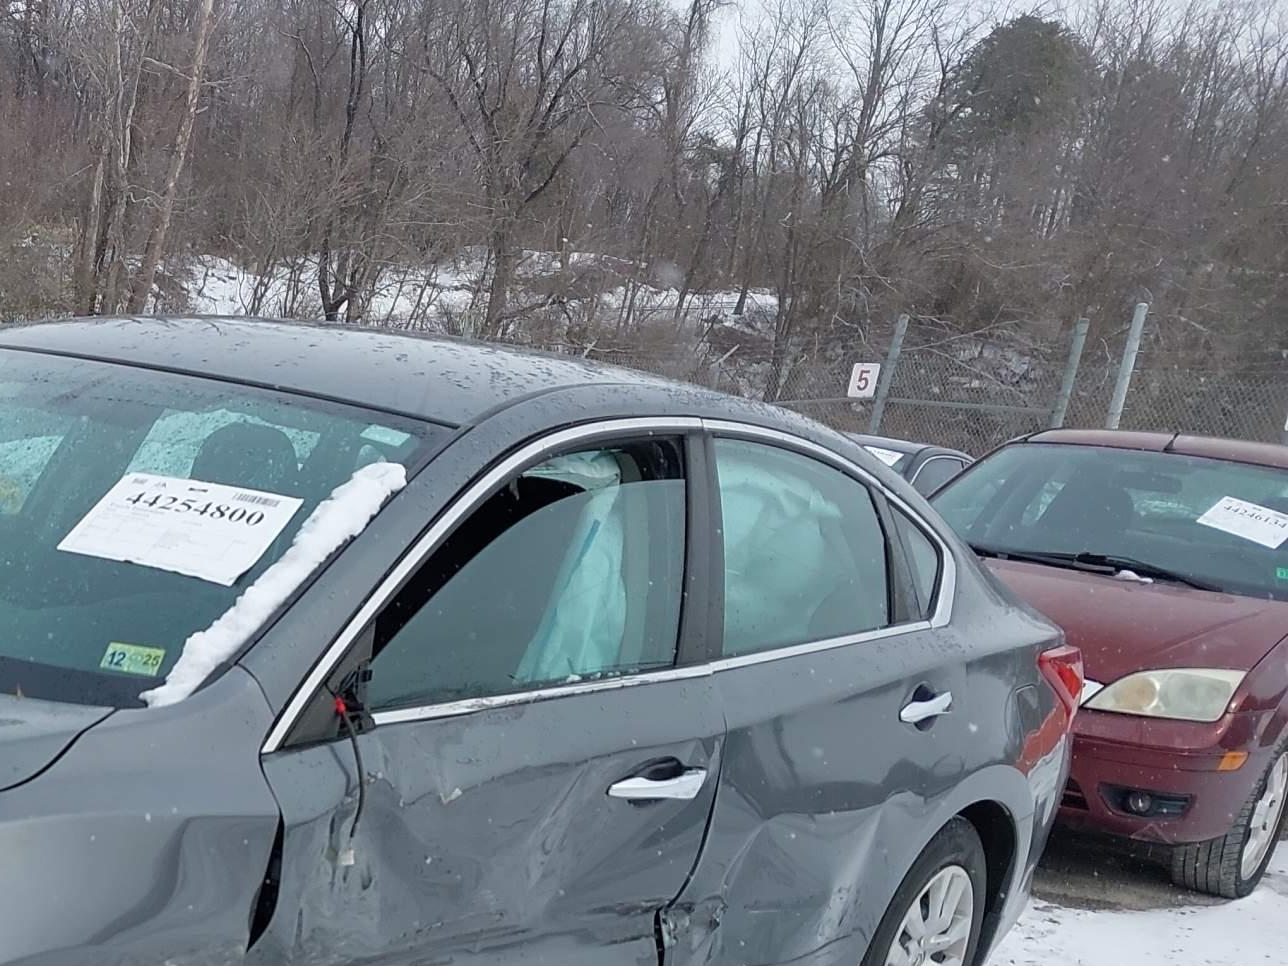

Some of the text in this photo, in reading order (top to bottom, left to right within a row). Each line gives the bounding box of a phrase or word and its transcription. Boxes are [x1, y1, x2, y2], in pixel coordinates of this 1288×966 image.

[857, 369, 871, 391] 5
[125, 491, 265, 526] 44254800
[109, 650, 161, 667] 12 25
